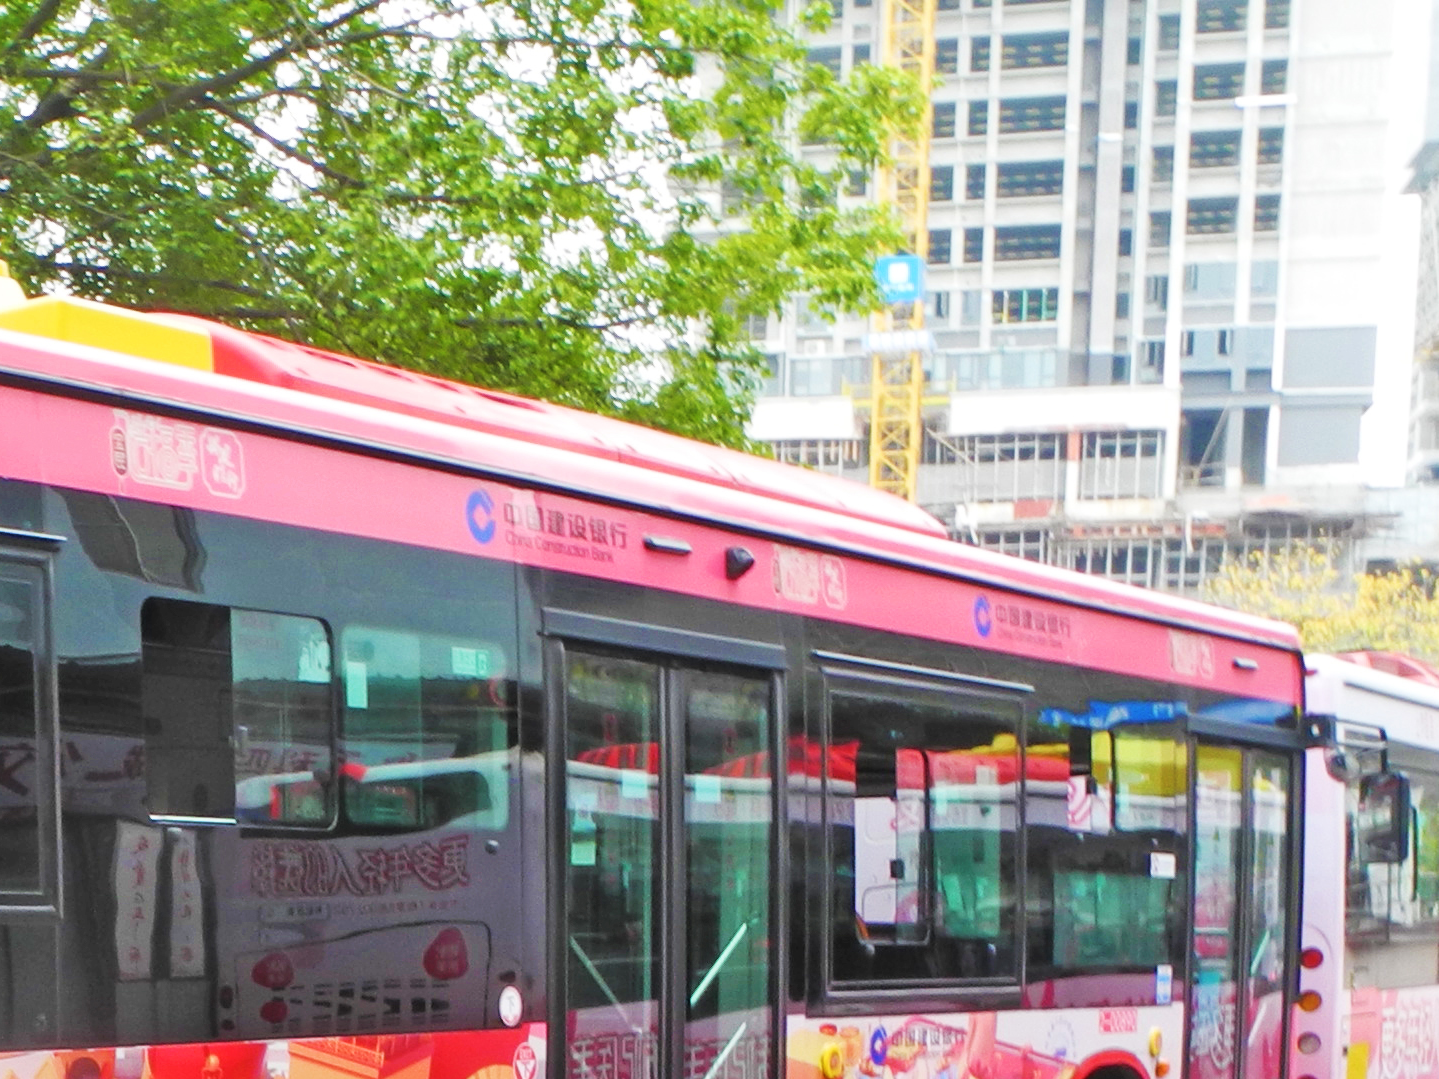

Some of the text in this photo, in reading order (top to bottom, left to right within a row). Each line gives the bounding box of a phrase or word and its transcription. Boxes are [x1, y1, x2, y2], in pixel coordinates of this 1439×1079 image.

[503, 503, 629, 550] 中国建设银行
